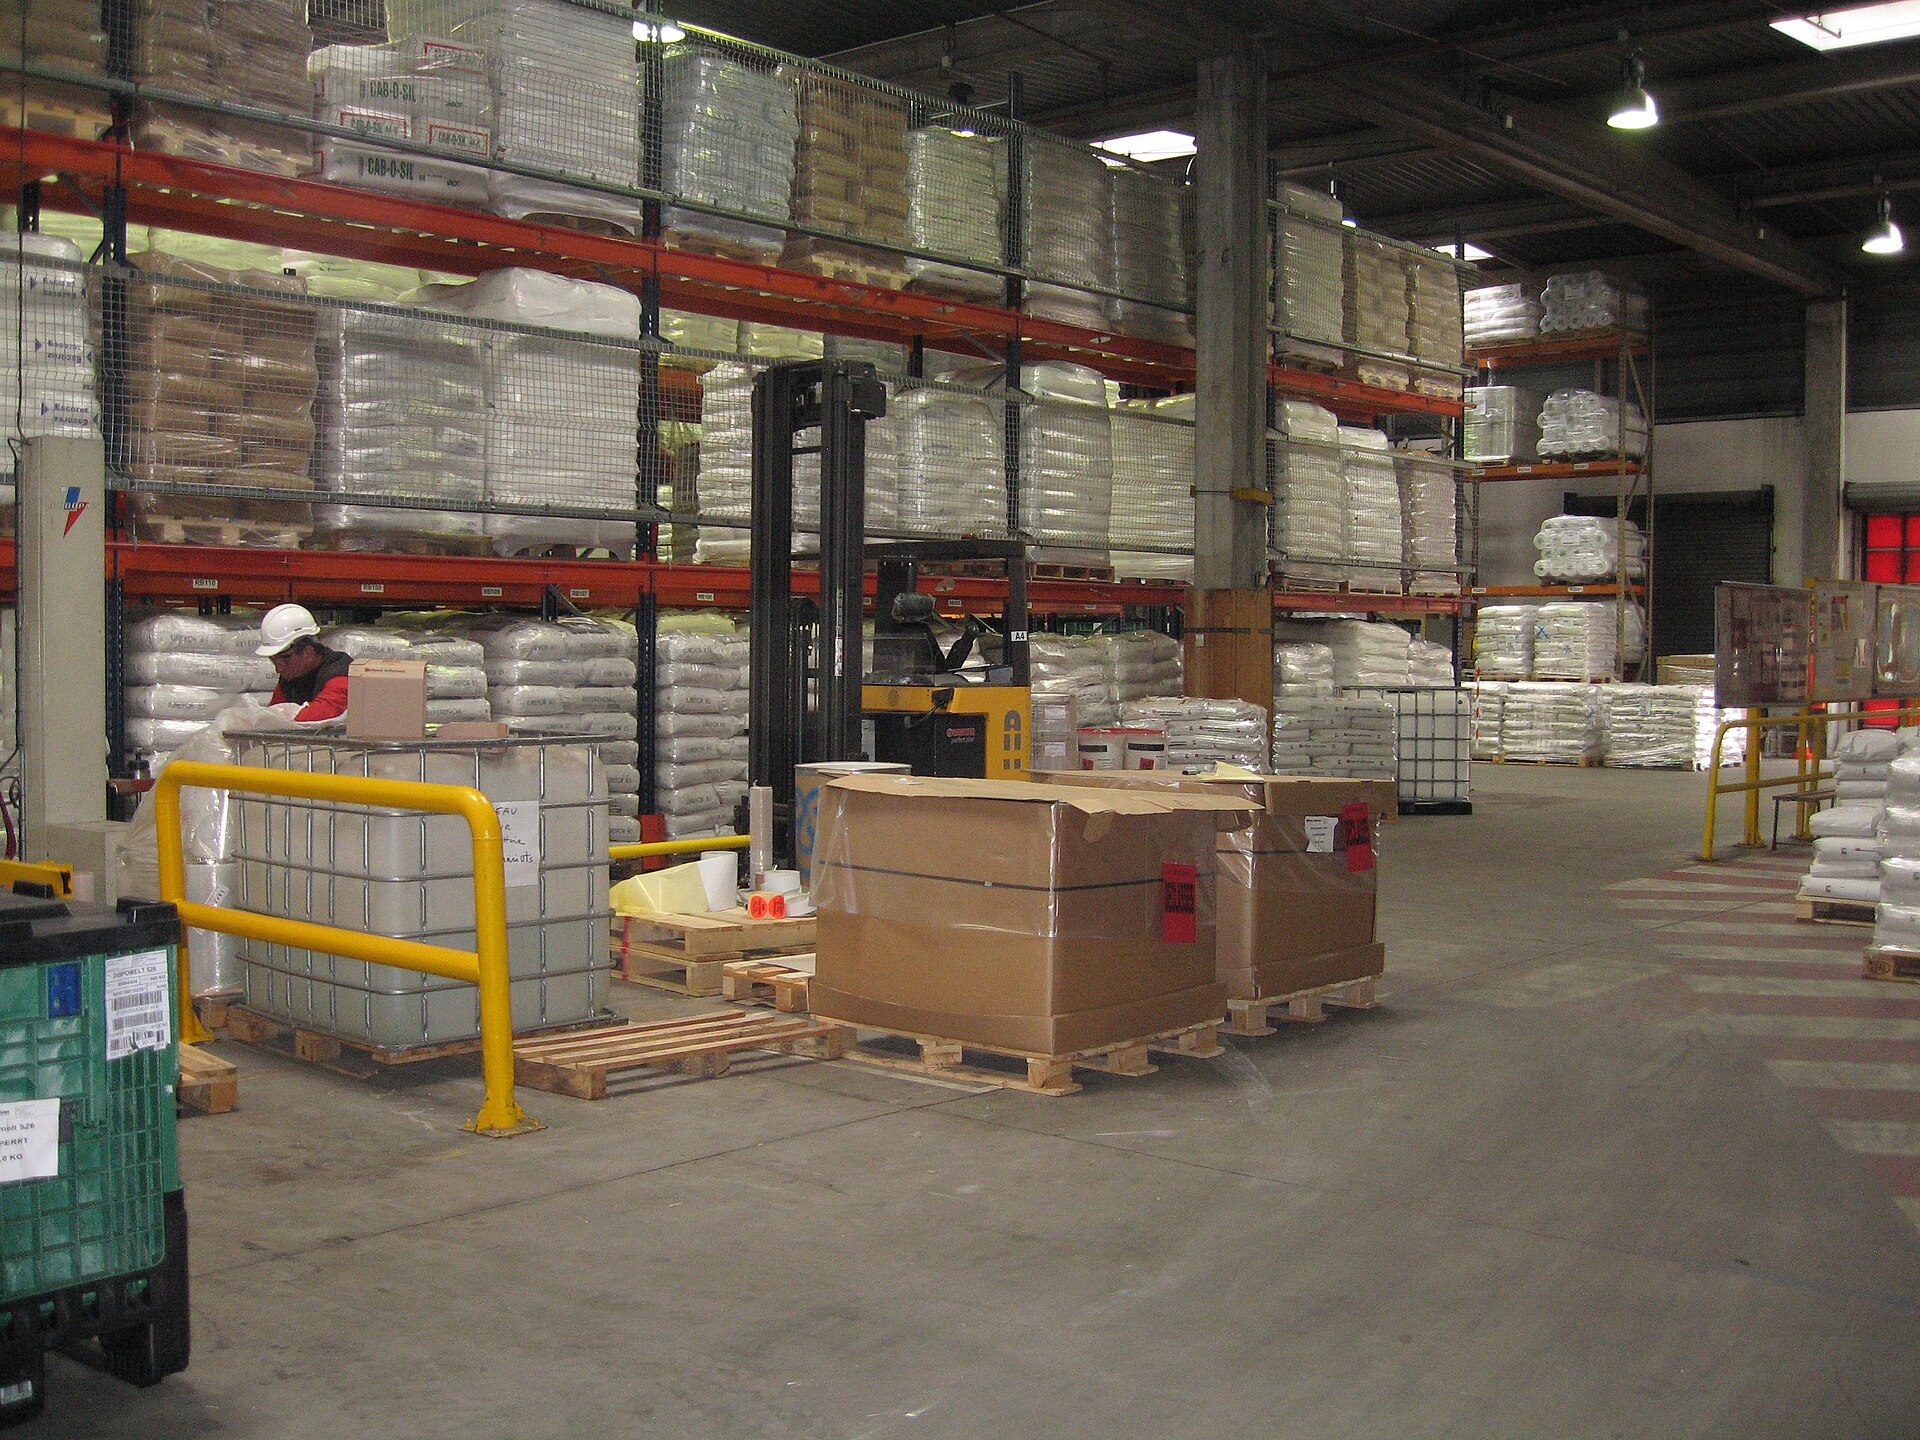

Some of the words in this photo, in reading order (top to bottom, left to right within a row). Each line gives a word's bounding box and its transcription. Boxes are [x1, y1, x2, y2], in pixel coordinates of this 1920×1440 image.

[370, 81, 416, 102] CAB-O-SIL
[367, 157, 415, 181] CAB-O-SIL
[54, 403, 89, 414] Escorez
[1015, 631, 1025, 641] A4
[496, 806, 517, 815] EAU
[113, 966, 146, 979] DISPOMELT
[147, 965, 157, 973] 526
[19, 1122, 35, 1130] 526
